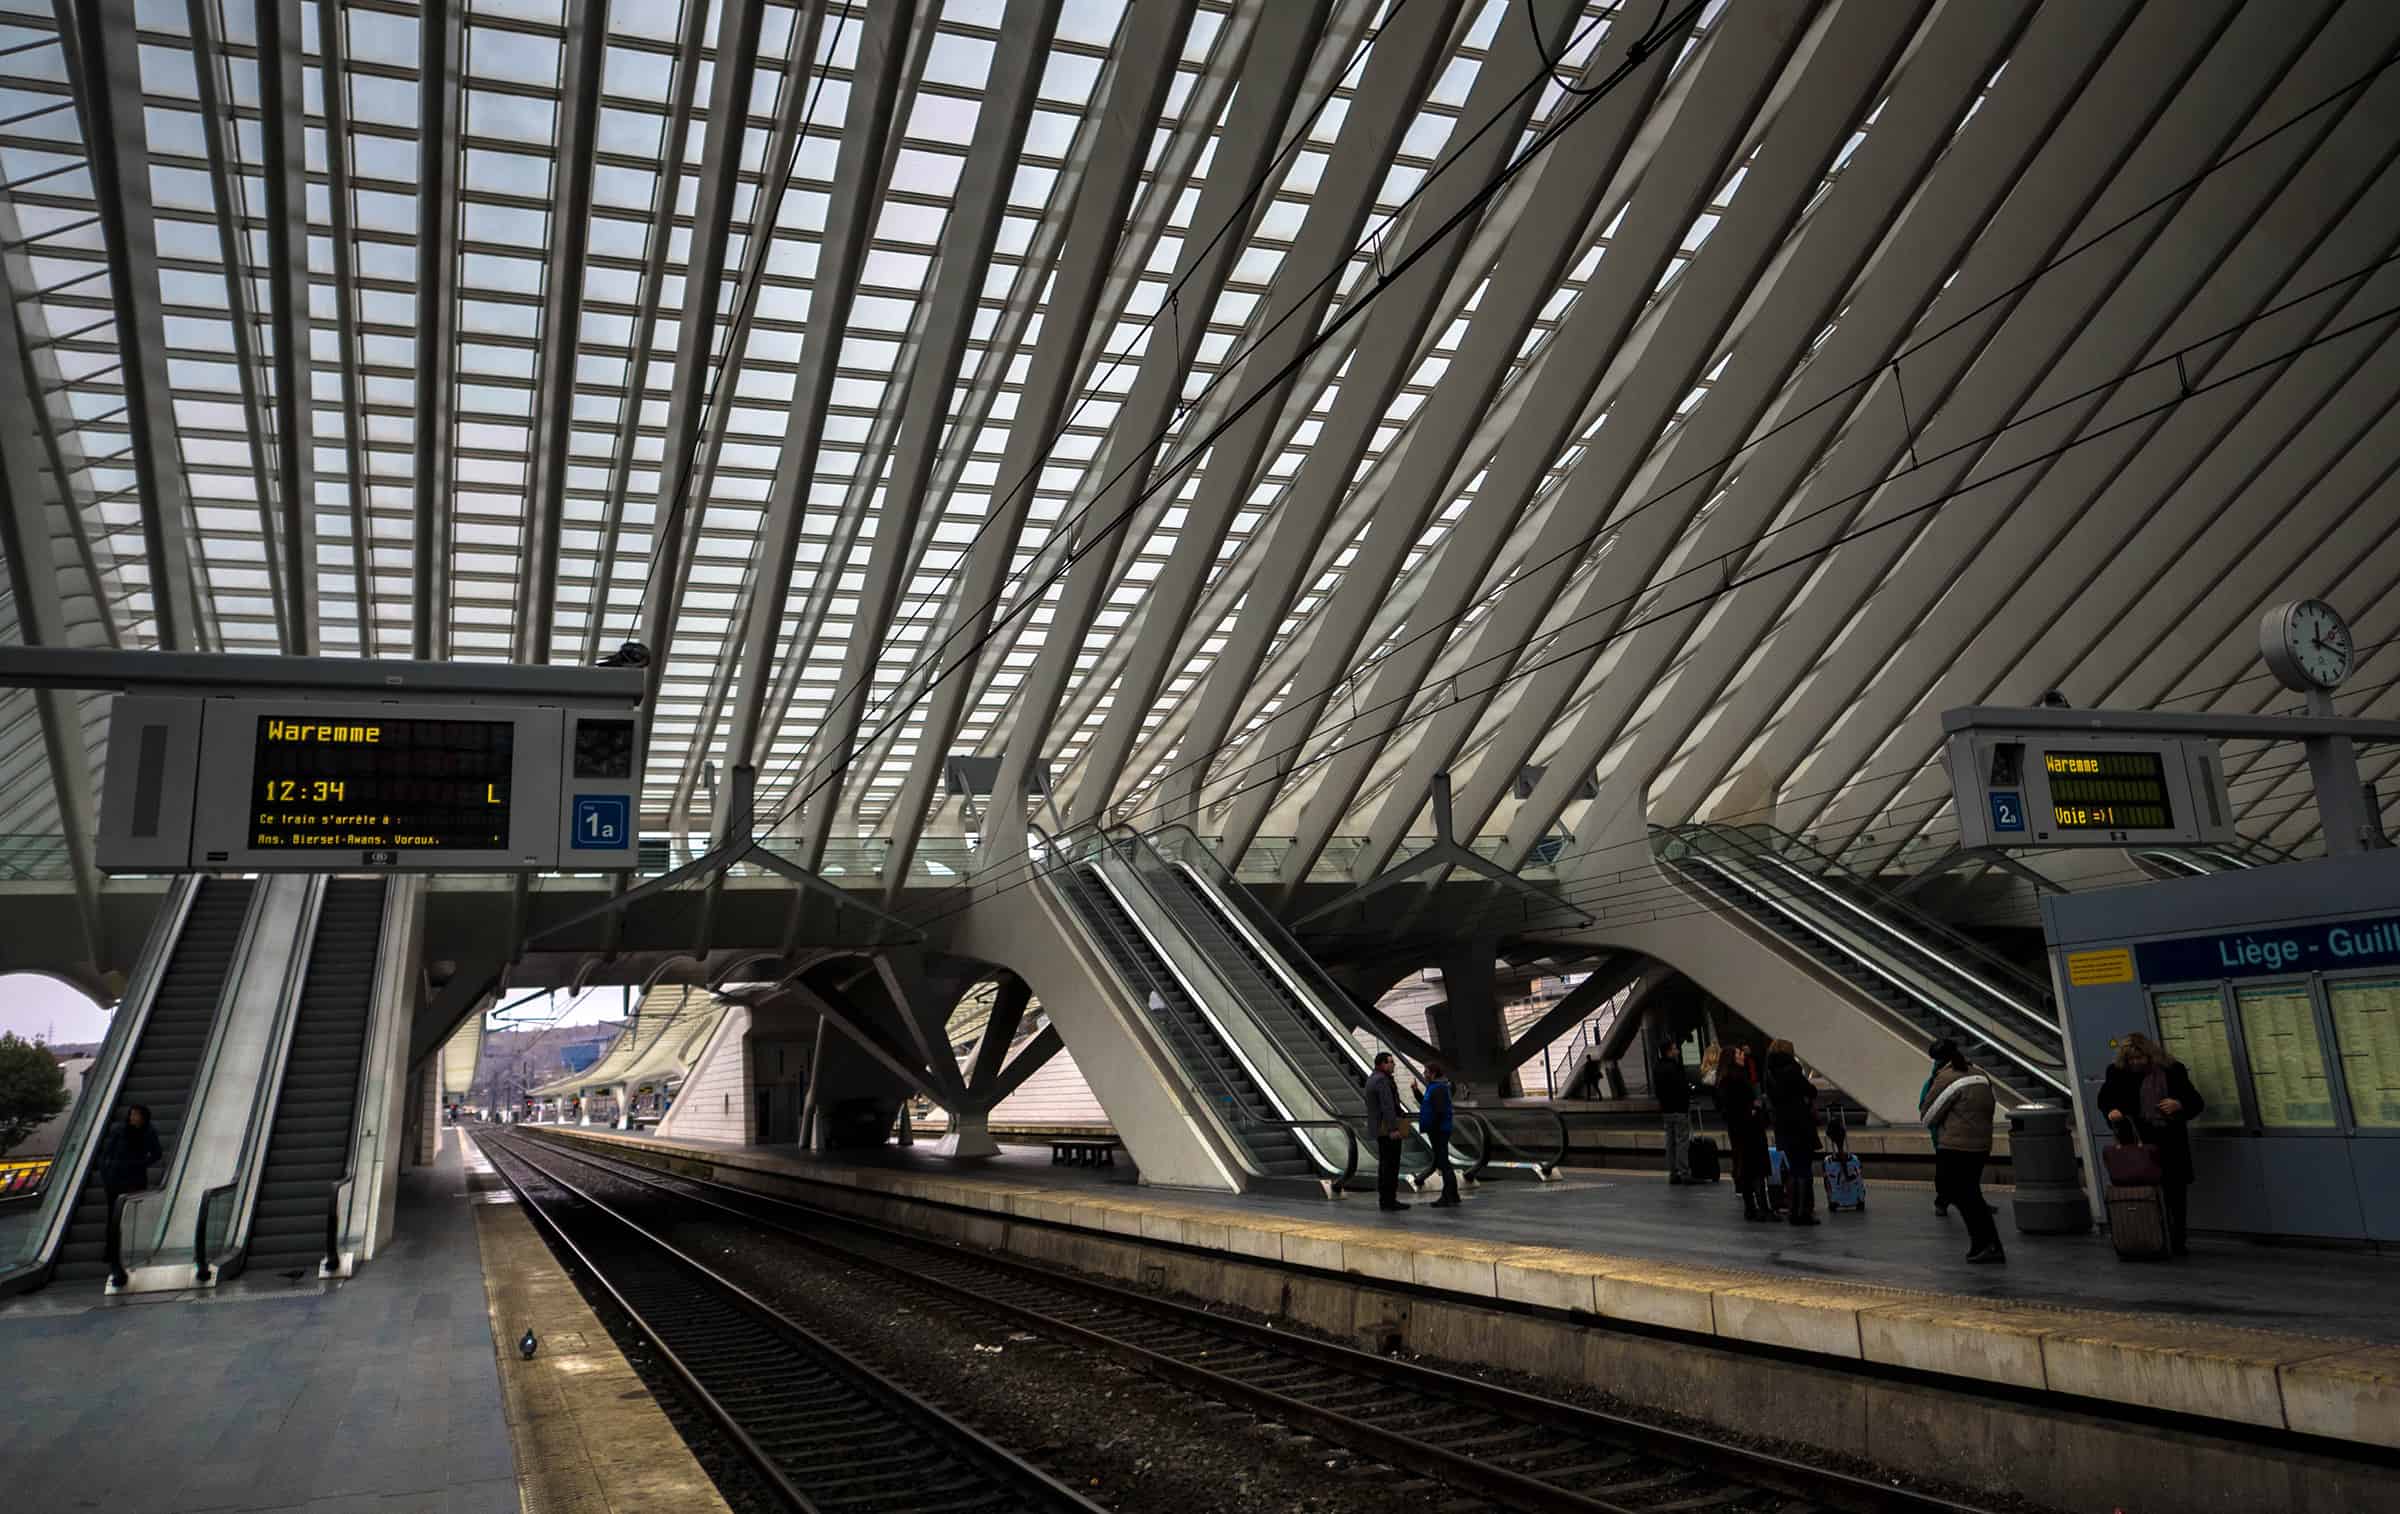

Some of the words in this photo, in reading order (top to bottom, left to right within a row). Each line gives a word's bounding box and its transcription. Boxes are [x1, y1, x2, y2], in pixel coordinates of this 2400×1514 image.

[268, 719, 381, 744] Waremme
[2045, 754, 2099, 774] Waremme
[265, 780, 345, 802] 12:34
[487, 783, 502, 804] L
[260, 813, 274, 825] Ce
[282, 814, 316, 825] train
[585, 811, 615, 838] 1a
[2054, 806, 2087, 825] Voie
[2219, 937, 2299, 969] Liège
[2308, 944, 2320, 952] -
